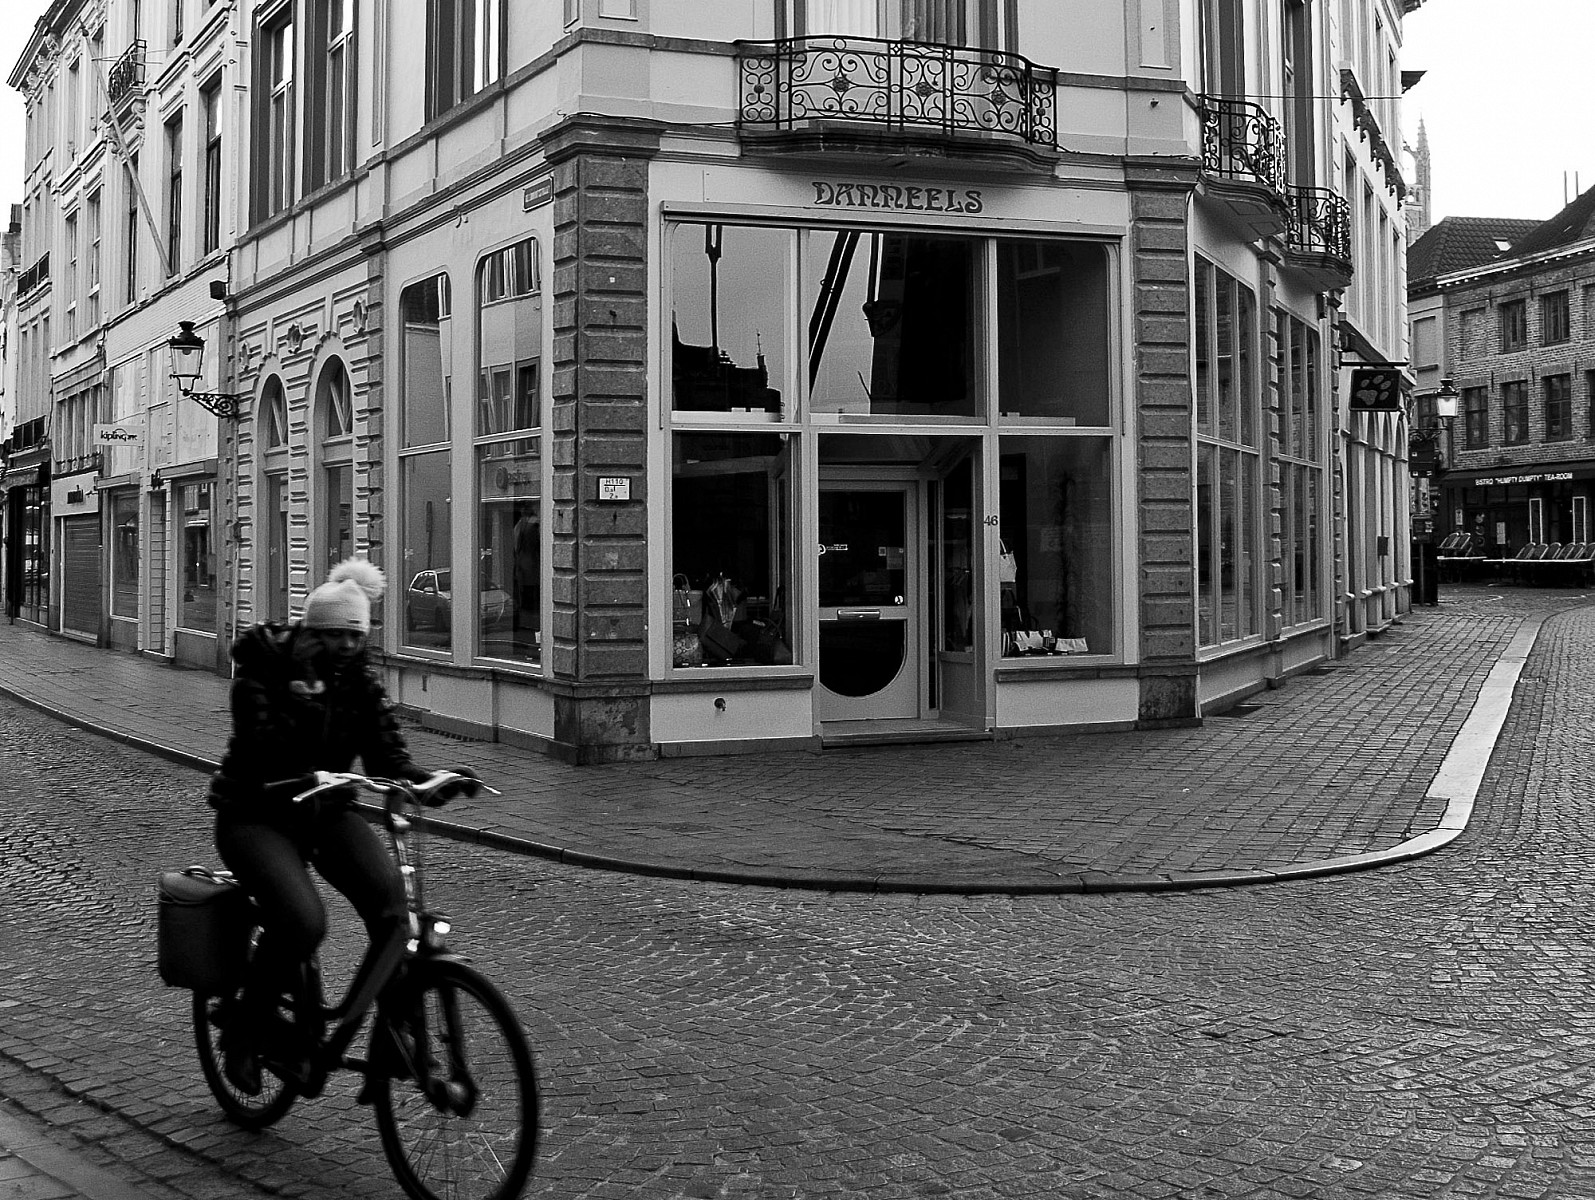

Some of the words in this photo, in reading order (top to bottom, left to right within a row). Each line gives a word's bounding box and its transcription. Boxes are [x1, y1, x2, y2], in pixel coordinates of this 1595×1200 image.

[812, 181, 983, 213] DANNEELS
[1475, 478, 1494, 486] BISTRO
[984, 515, 998, 526] 46
